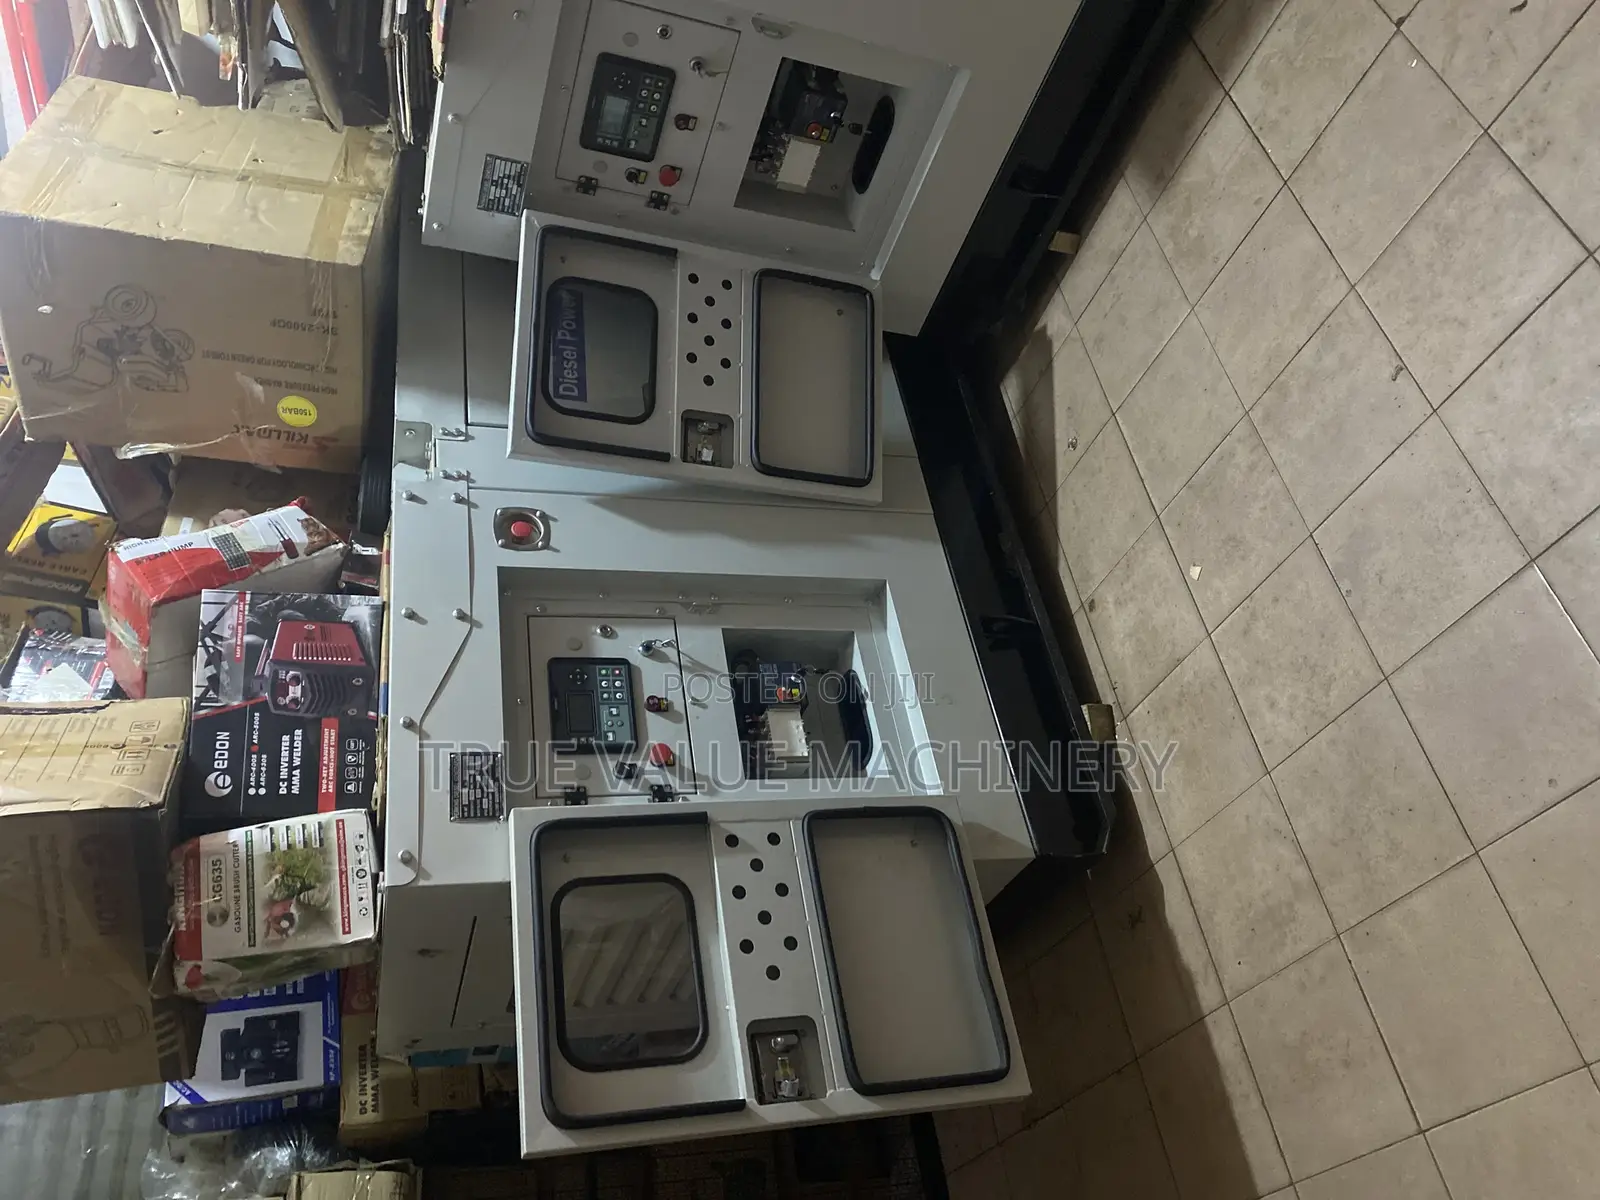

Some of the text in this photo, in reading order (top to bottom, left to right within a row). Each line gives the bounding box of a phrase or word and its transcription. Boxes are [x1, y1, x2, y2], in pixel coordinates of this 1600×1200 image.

[557, 290, 578, 396] Diesel Power
[280, 406, 312, 416] 150BAR
[252, 712, 260, 744] ARC-500S
[322, 728, 330, 764] ADJUSTMENT
[250, 754, 258, 786] ARC-400S
[279, 734, 290, 794] DC INVERTER
[291, 728, 302, 794] MMA WELDER
[212, 859, 223, 903] CG635
[231, 844, 242, 933] GASOLINE BRUSH CUTTER
[358, 1044, 368, 1115] DC INVERTER
[370, 1084, 380, 1114] MMA
